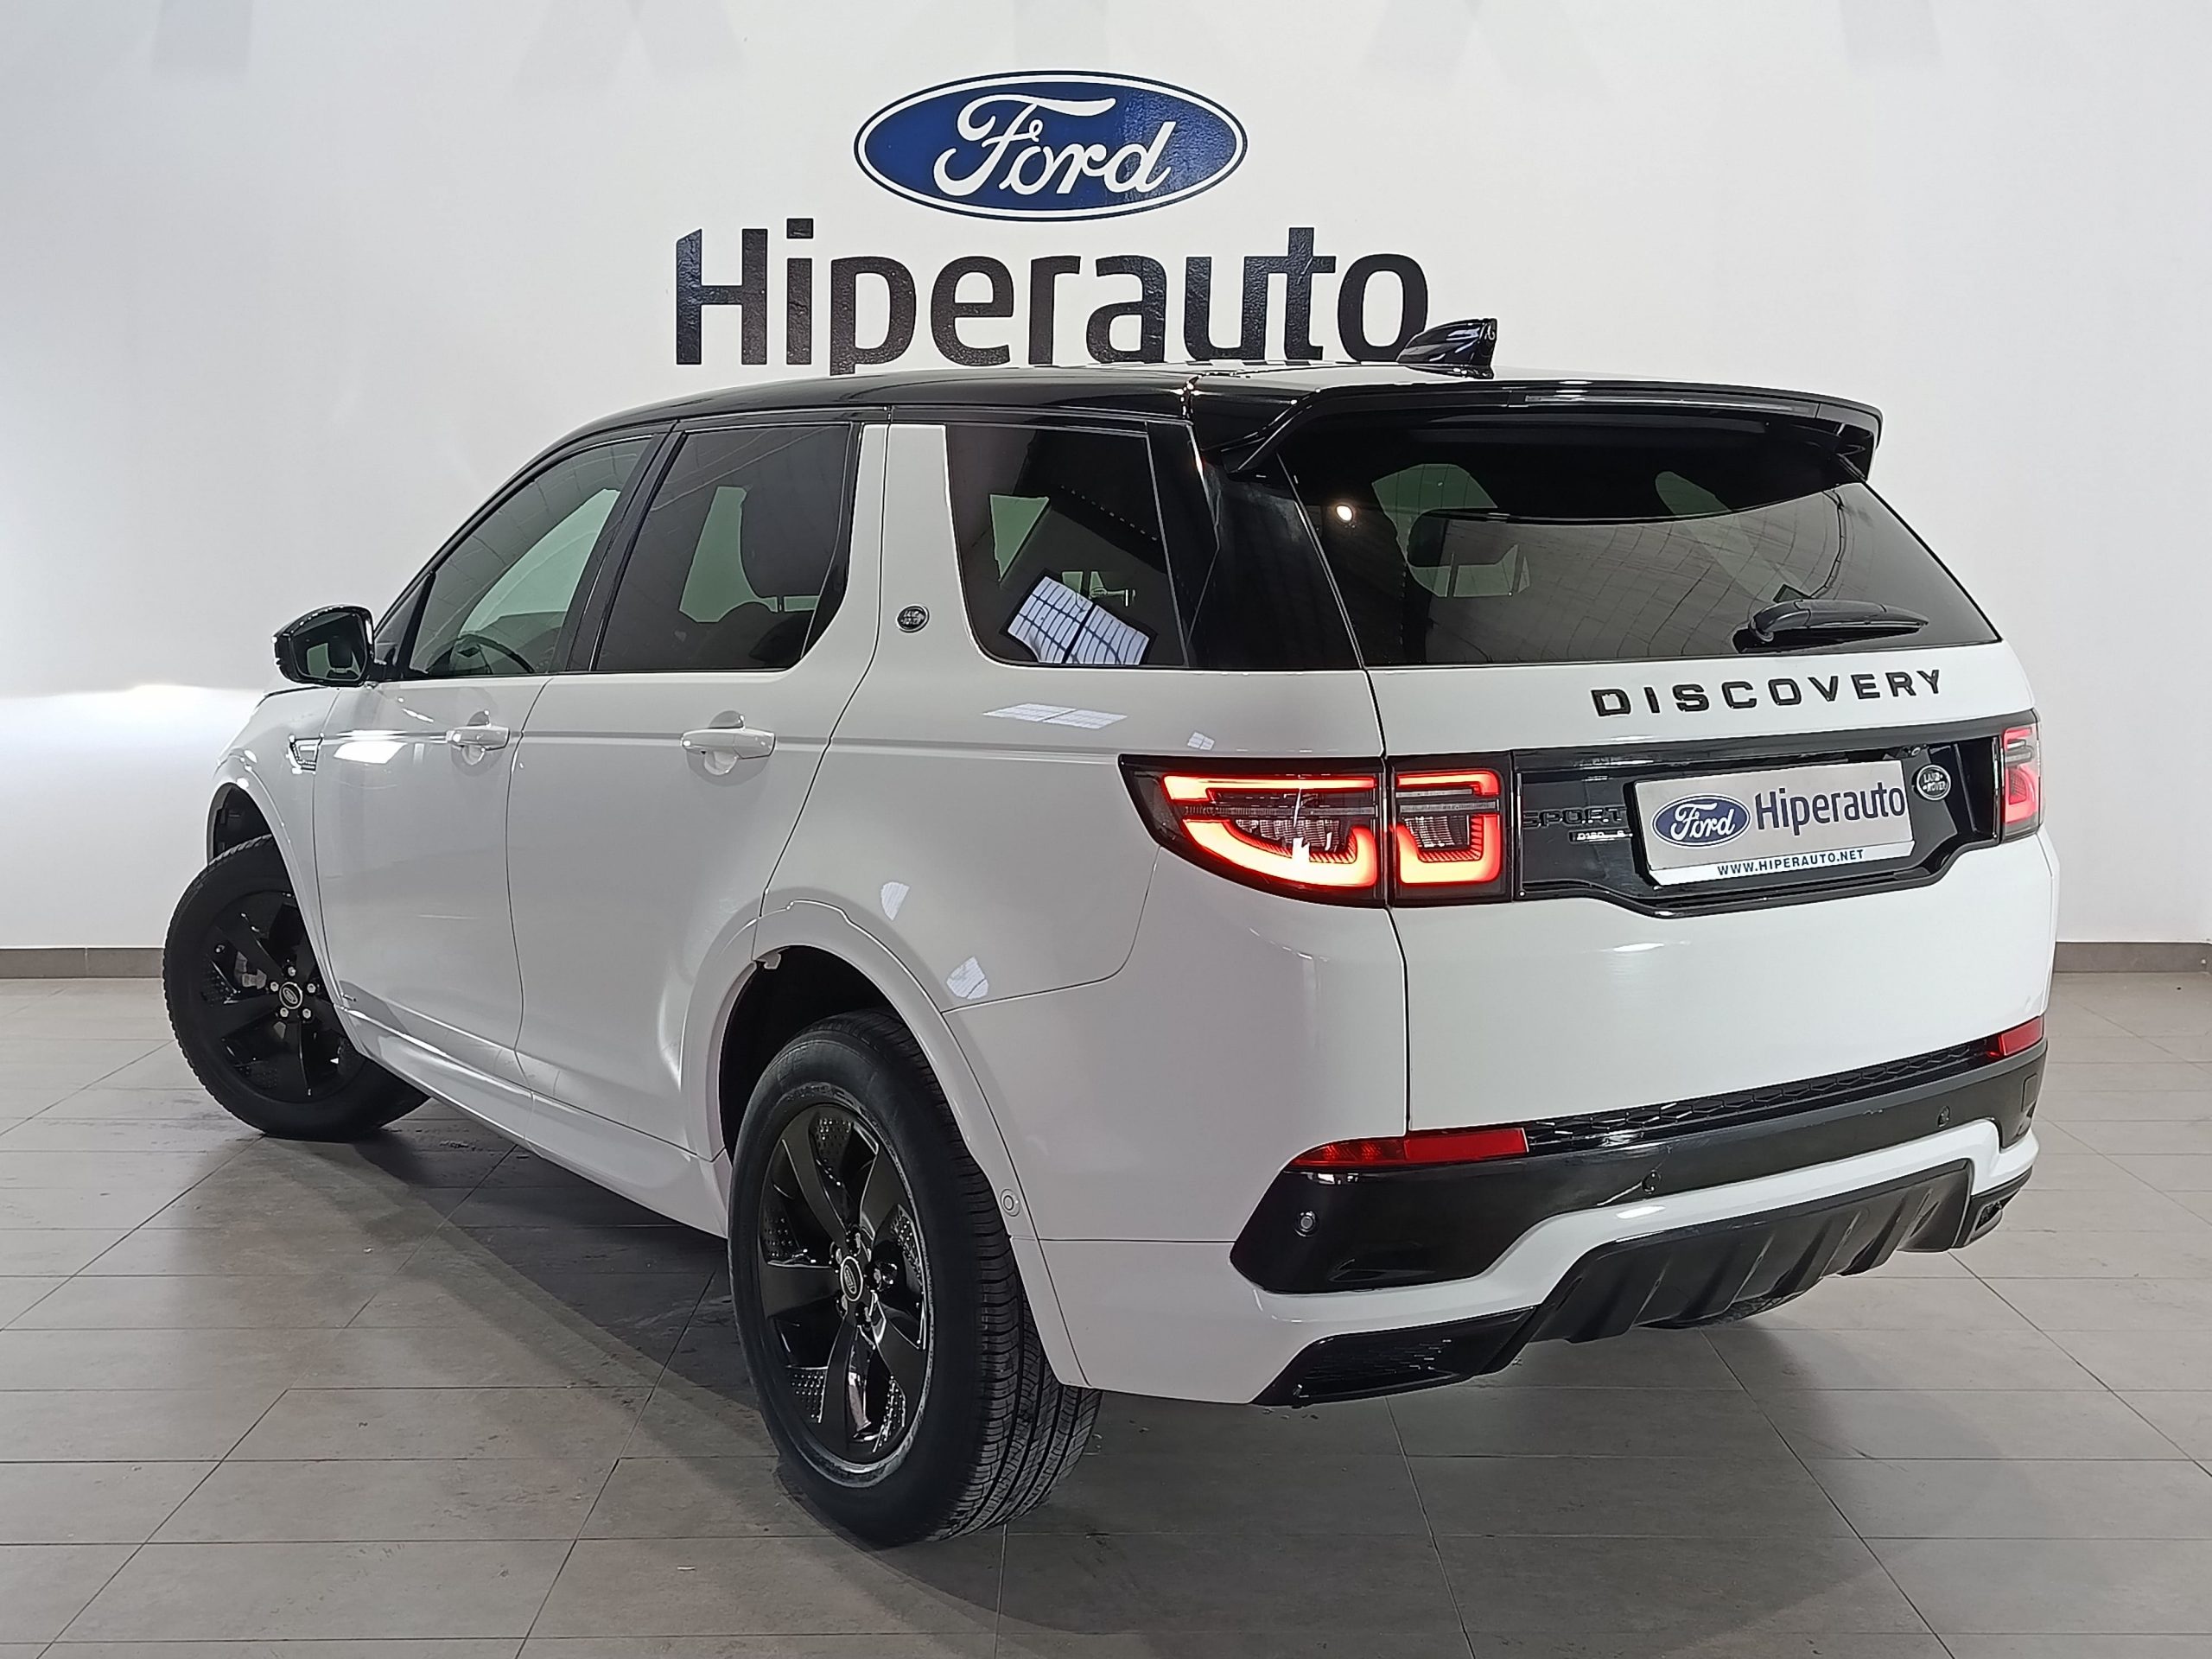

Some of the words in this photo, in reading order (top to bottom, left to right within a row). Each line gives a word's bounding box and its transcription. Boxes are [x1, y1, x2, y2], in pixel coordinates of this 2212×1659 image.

[933, 93, 1177, 197] Ford
[676, 218, 1429, 375] Hiperauto
[1592, 669, 1940, 717] DISCOVERY
[1522, 805, 1626, 828] SPORT
[1670, 802, 1736, 841] Ford
[1754, 782, 1906, 836] Hiperauto
[1717, 849, 1865, 875] WWW.HIPERAUTO.NET
